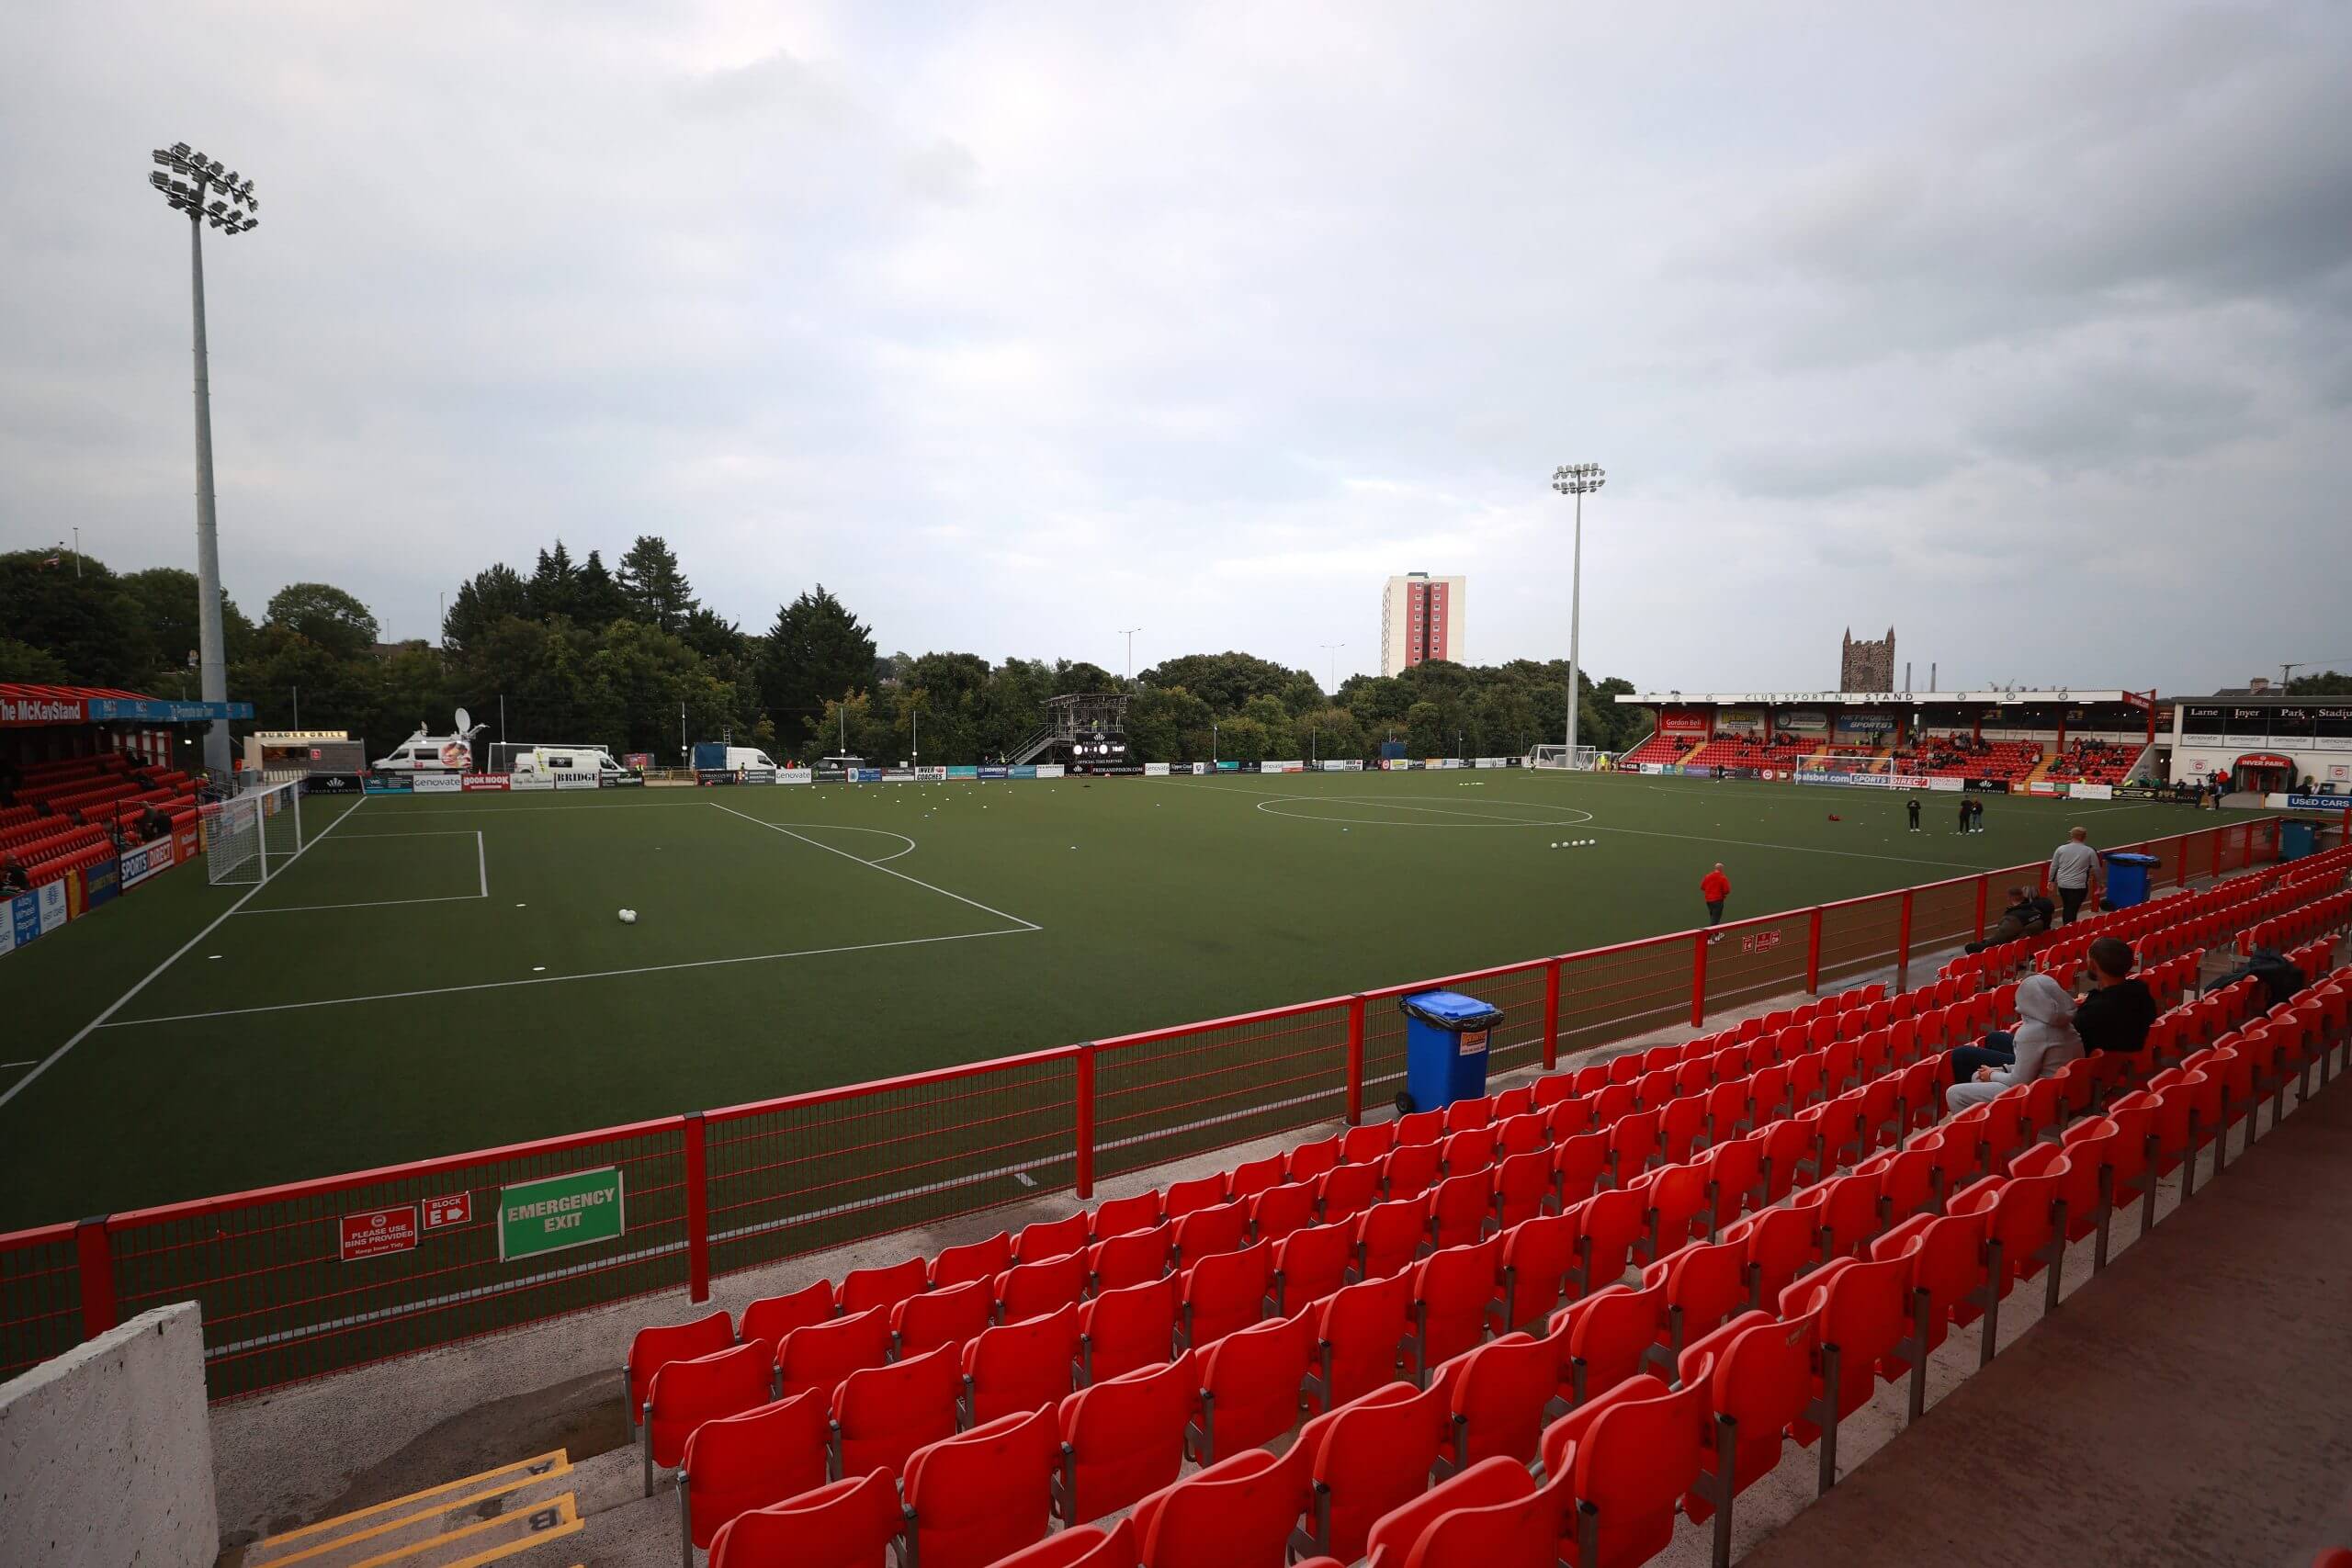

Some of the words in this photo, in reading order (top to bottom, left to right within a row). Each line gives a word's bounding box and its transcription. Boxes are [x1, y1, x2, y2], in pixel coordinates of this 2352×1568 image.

[1865, 693, 1913, 701] STAND
[2235, 708, 2260, 716] Inver
[2281, 708, 2304, 716] Park
[463, 776, 484, 785] BOOK
[485, 776, 509, 784] NOOK
[558, 773, 597, 781] BRIDGE
[1853, 775, 1887, 784] SPORTS
[1892, 778, 1928, 786] DIRECT
[2291, 797, 2319, 806] USED
[2321, 798, 2350, 807] CARS
[121, 854, 148, 881] SPORTS
[149, 842, 172, 867] DIRECT
[432, 1198, 462, 1209] BLOCK
[507, 1187, 616, 1222] EMERGENCY
[430, 1210, 441, 1225] E
[544, 1213, 582, 1233] EXIT
[351, 1226, 386, 1239] PLEASE
[389, 1224, 406, 1235] USE
[345, 1236, 368, 1247] BINS
[368, 1231, 413, 1244] PROVIDED
[355, 1247, 372, 1255] Keep
[390, 1242, 404, 1250] Tidy
